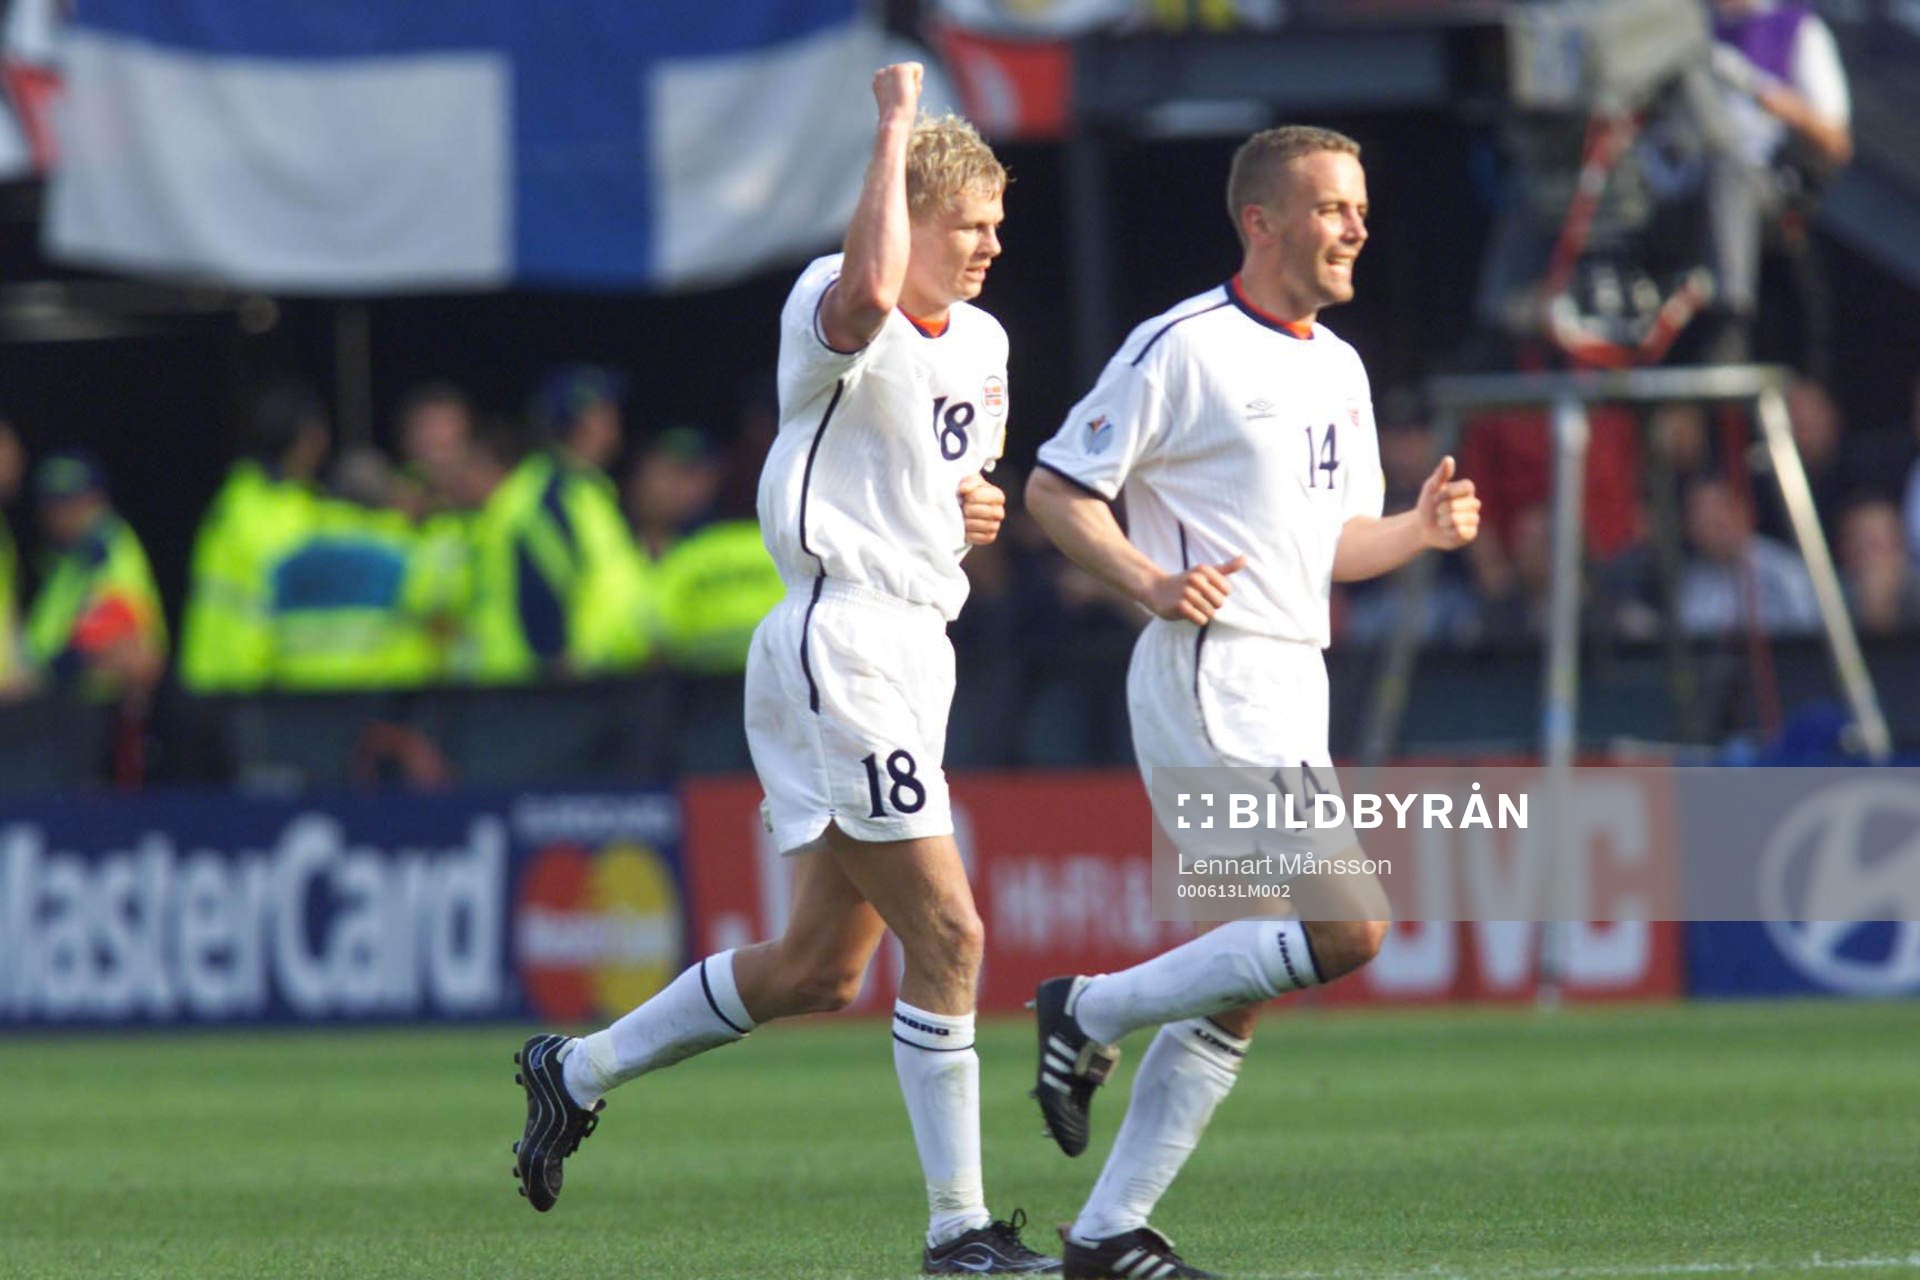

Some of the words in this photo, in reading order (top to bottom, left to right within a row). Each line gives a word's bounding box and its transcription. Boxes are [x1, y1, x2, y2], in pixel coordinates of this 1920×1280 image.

[932, 395, 975, 461] 18
[1305, 423, 1340, 490] 14
[861, 749, 926, 818] 18
[1270, 760, 1337, 833] 14
[1366, 776, 1650, 992] JVC
[893, 1010, 949, 1036] MBRO
